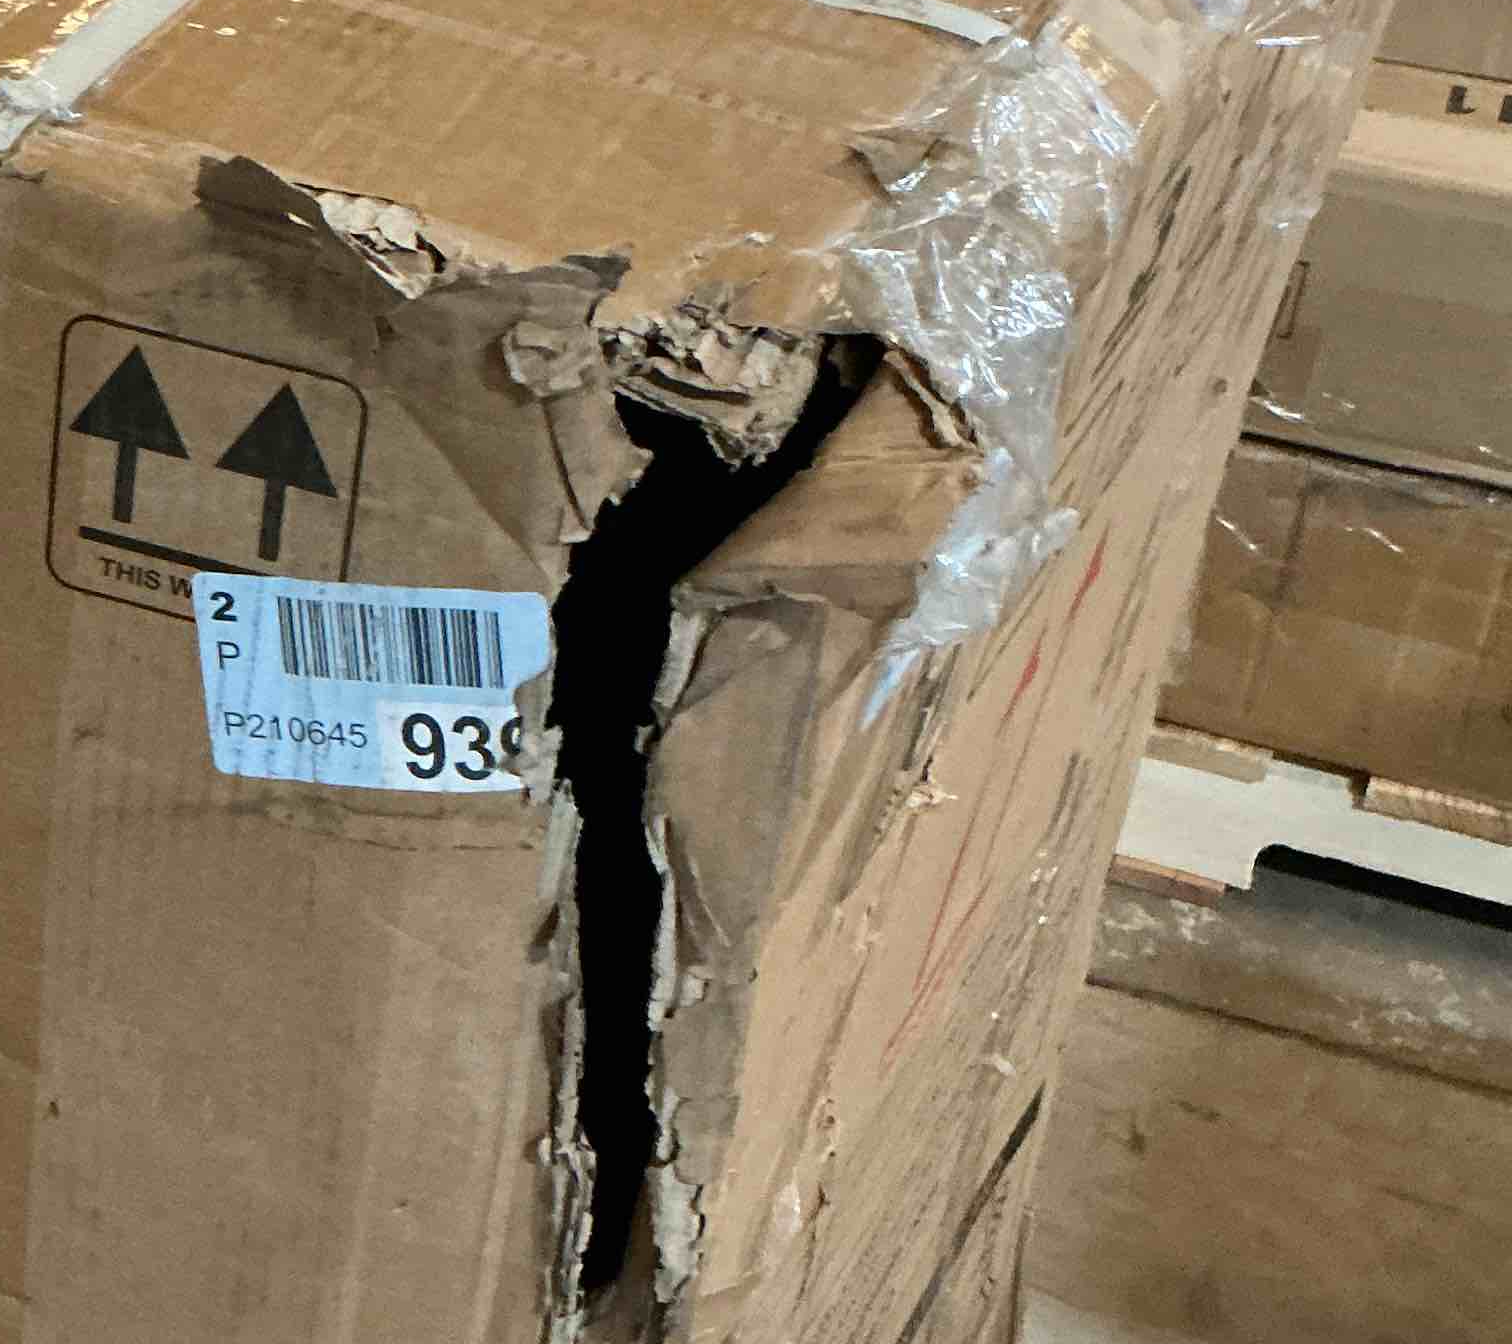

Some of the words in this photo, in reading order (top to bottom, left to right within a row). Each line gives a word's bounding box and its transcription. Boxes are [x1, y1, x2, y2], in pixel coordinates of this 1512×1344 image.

[98, 556, 162, 591] THIS
[209, 591, 238, 622] 2
[216, 640, 240, 671] P
[223, 711, 368, 749] P210645
